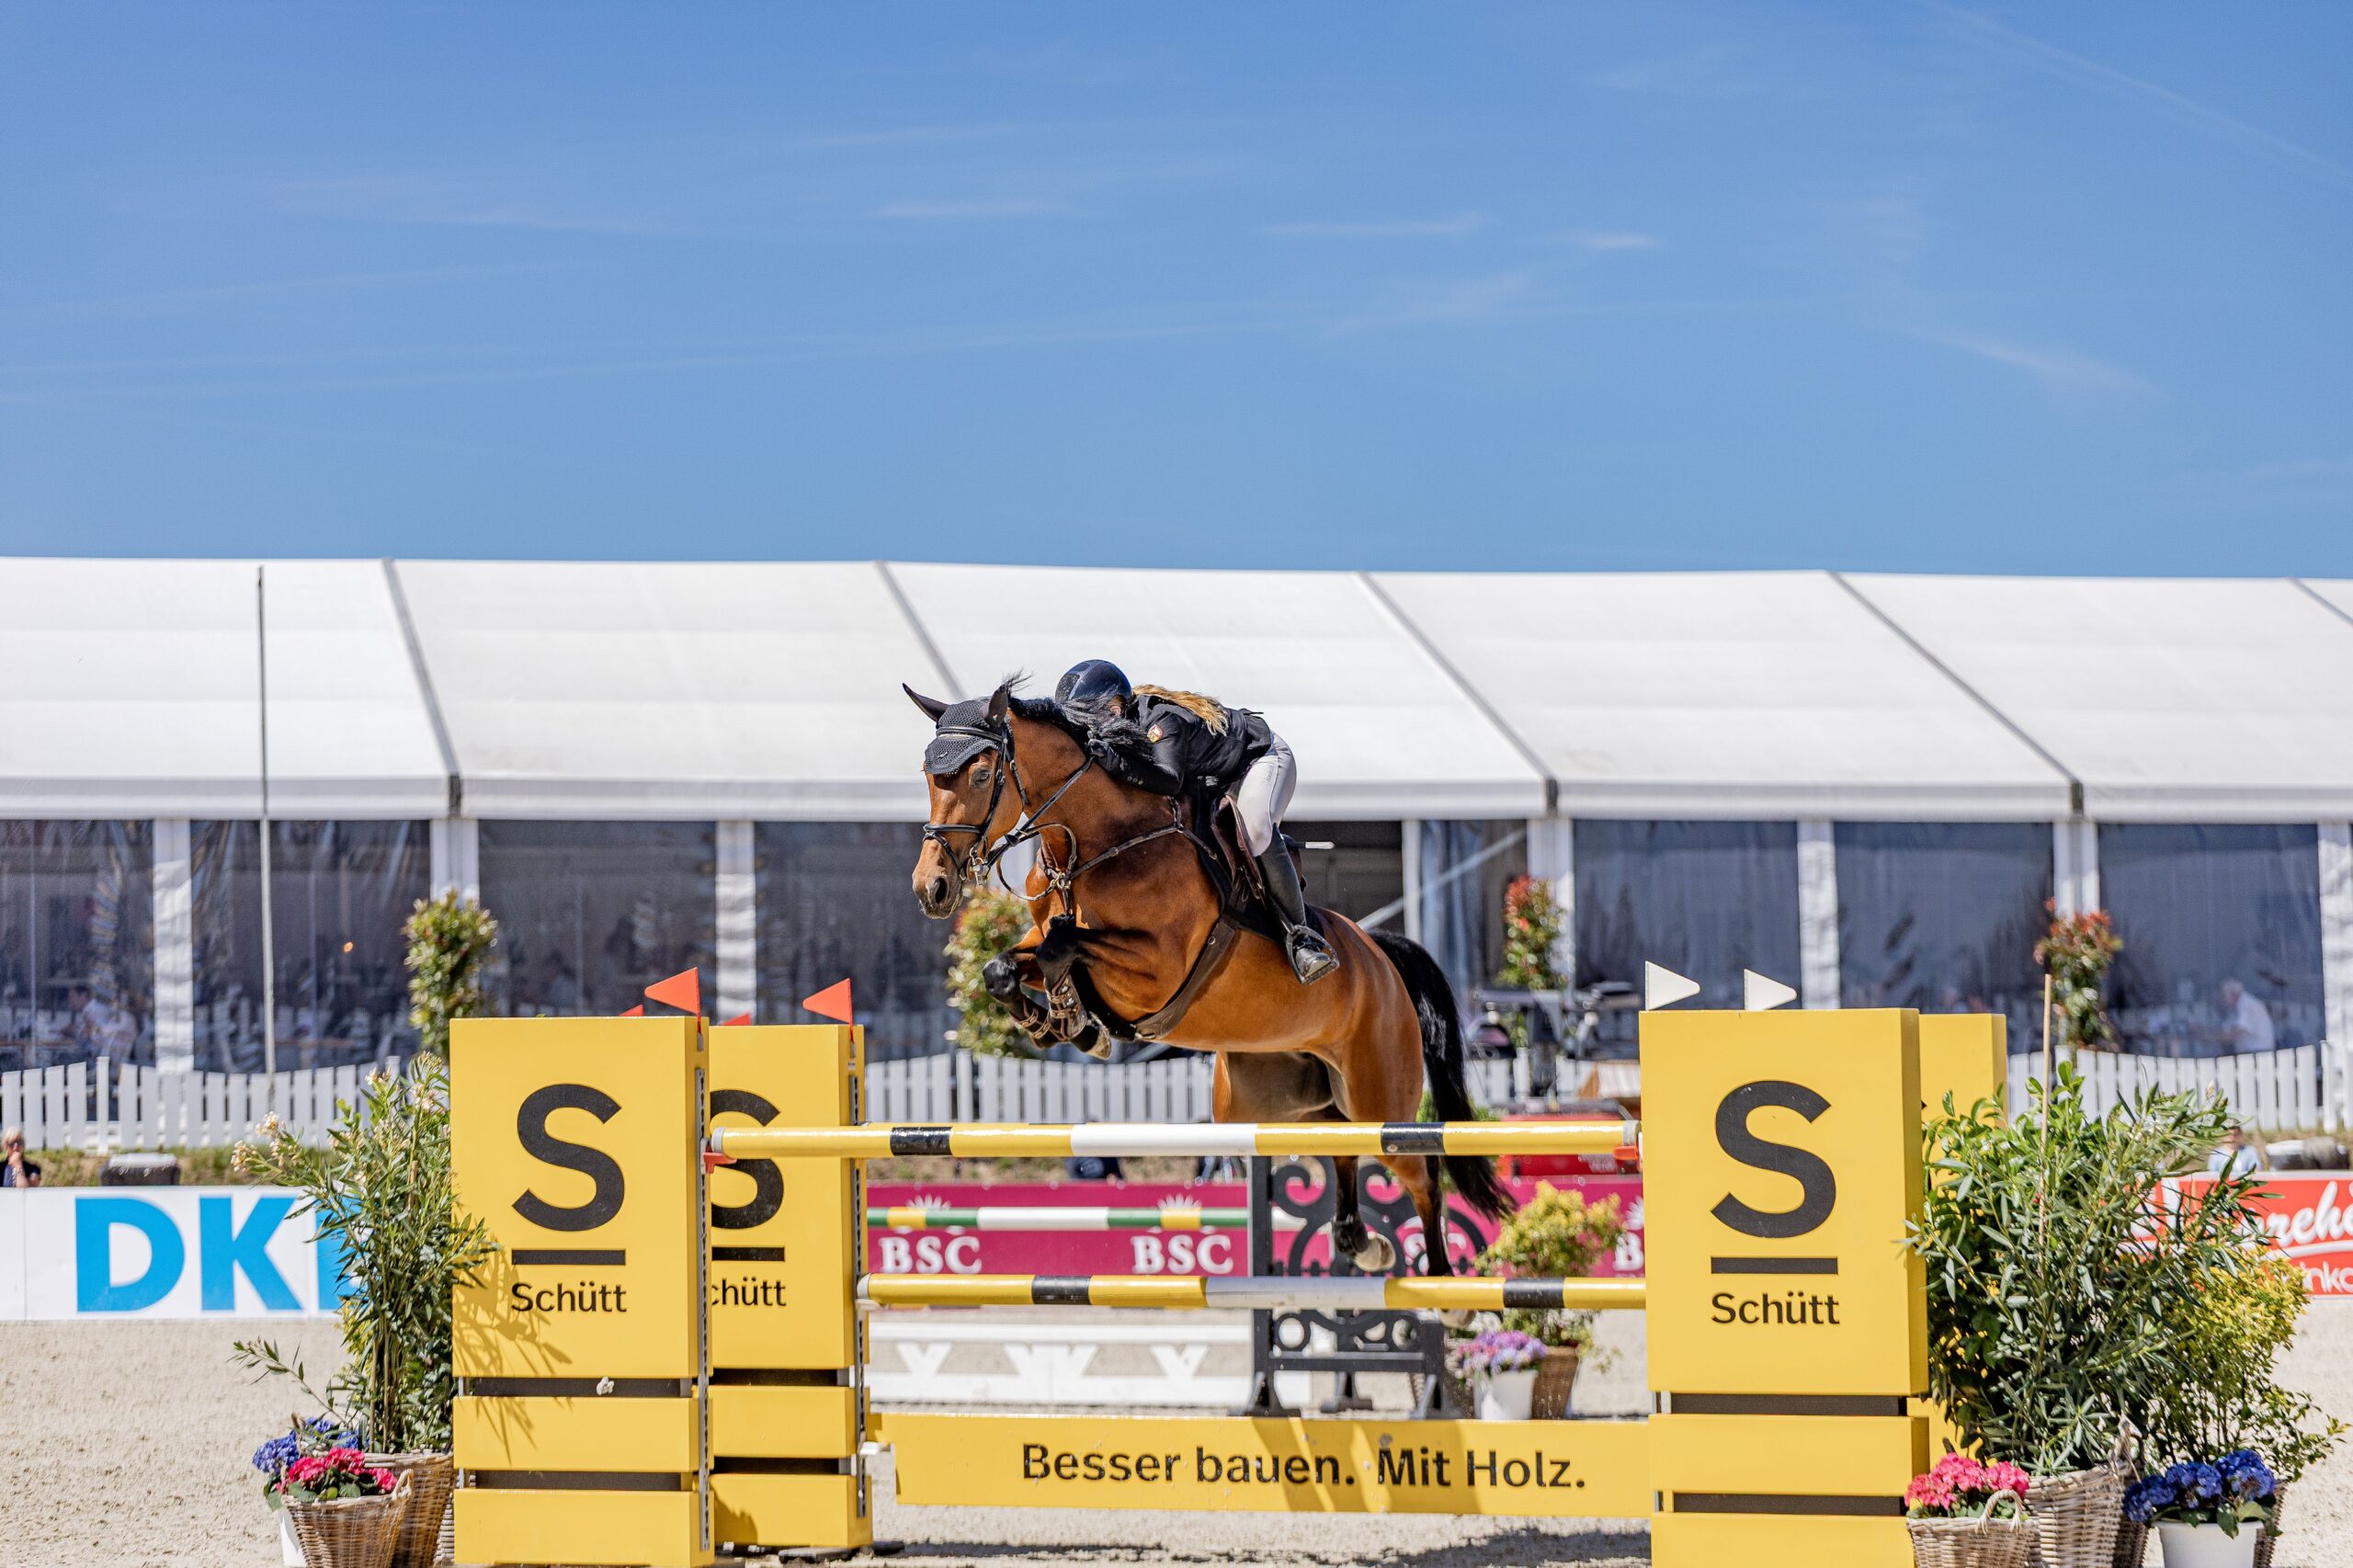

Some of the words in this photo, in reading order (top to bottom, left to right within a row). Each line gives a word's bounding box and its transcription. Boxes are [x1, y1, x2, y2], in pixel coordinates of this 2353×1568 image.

[512, 1084, 625, 1233] S
[1711, 1080, 1837, 1239] S
[879, 1235, 983, 1275] BSC
[1131, 1235, 1233, 1275] BSC
[511, 1280, 627, 1312] Schütt
[1711, 1290, 1840, 1325] Schütt
[1023, 1444, 1180, 1483] Besser
[1196, 1446, 1356, 1486] bauen.
[1378, 1448, 1450, 1486] Mit
[1467, 1450, 1586, 1489] Holz.
